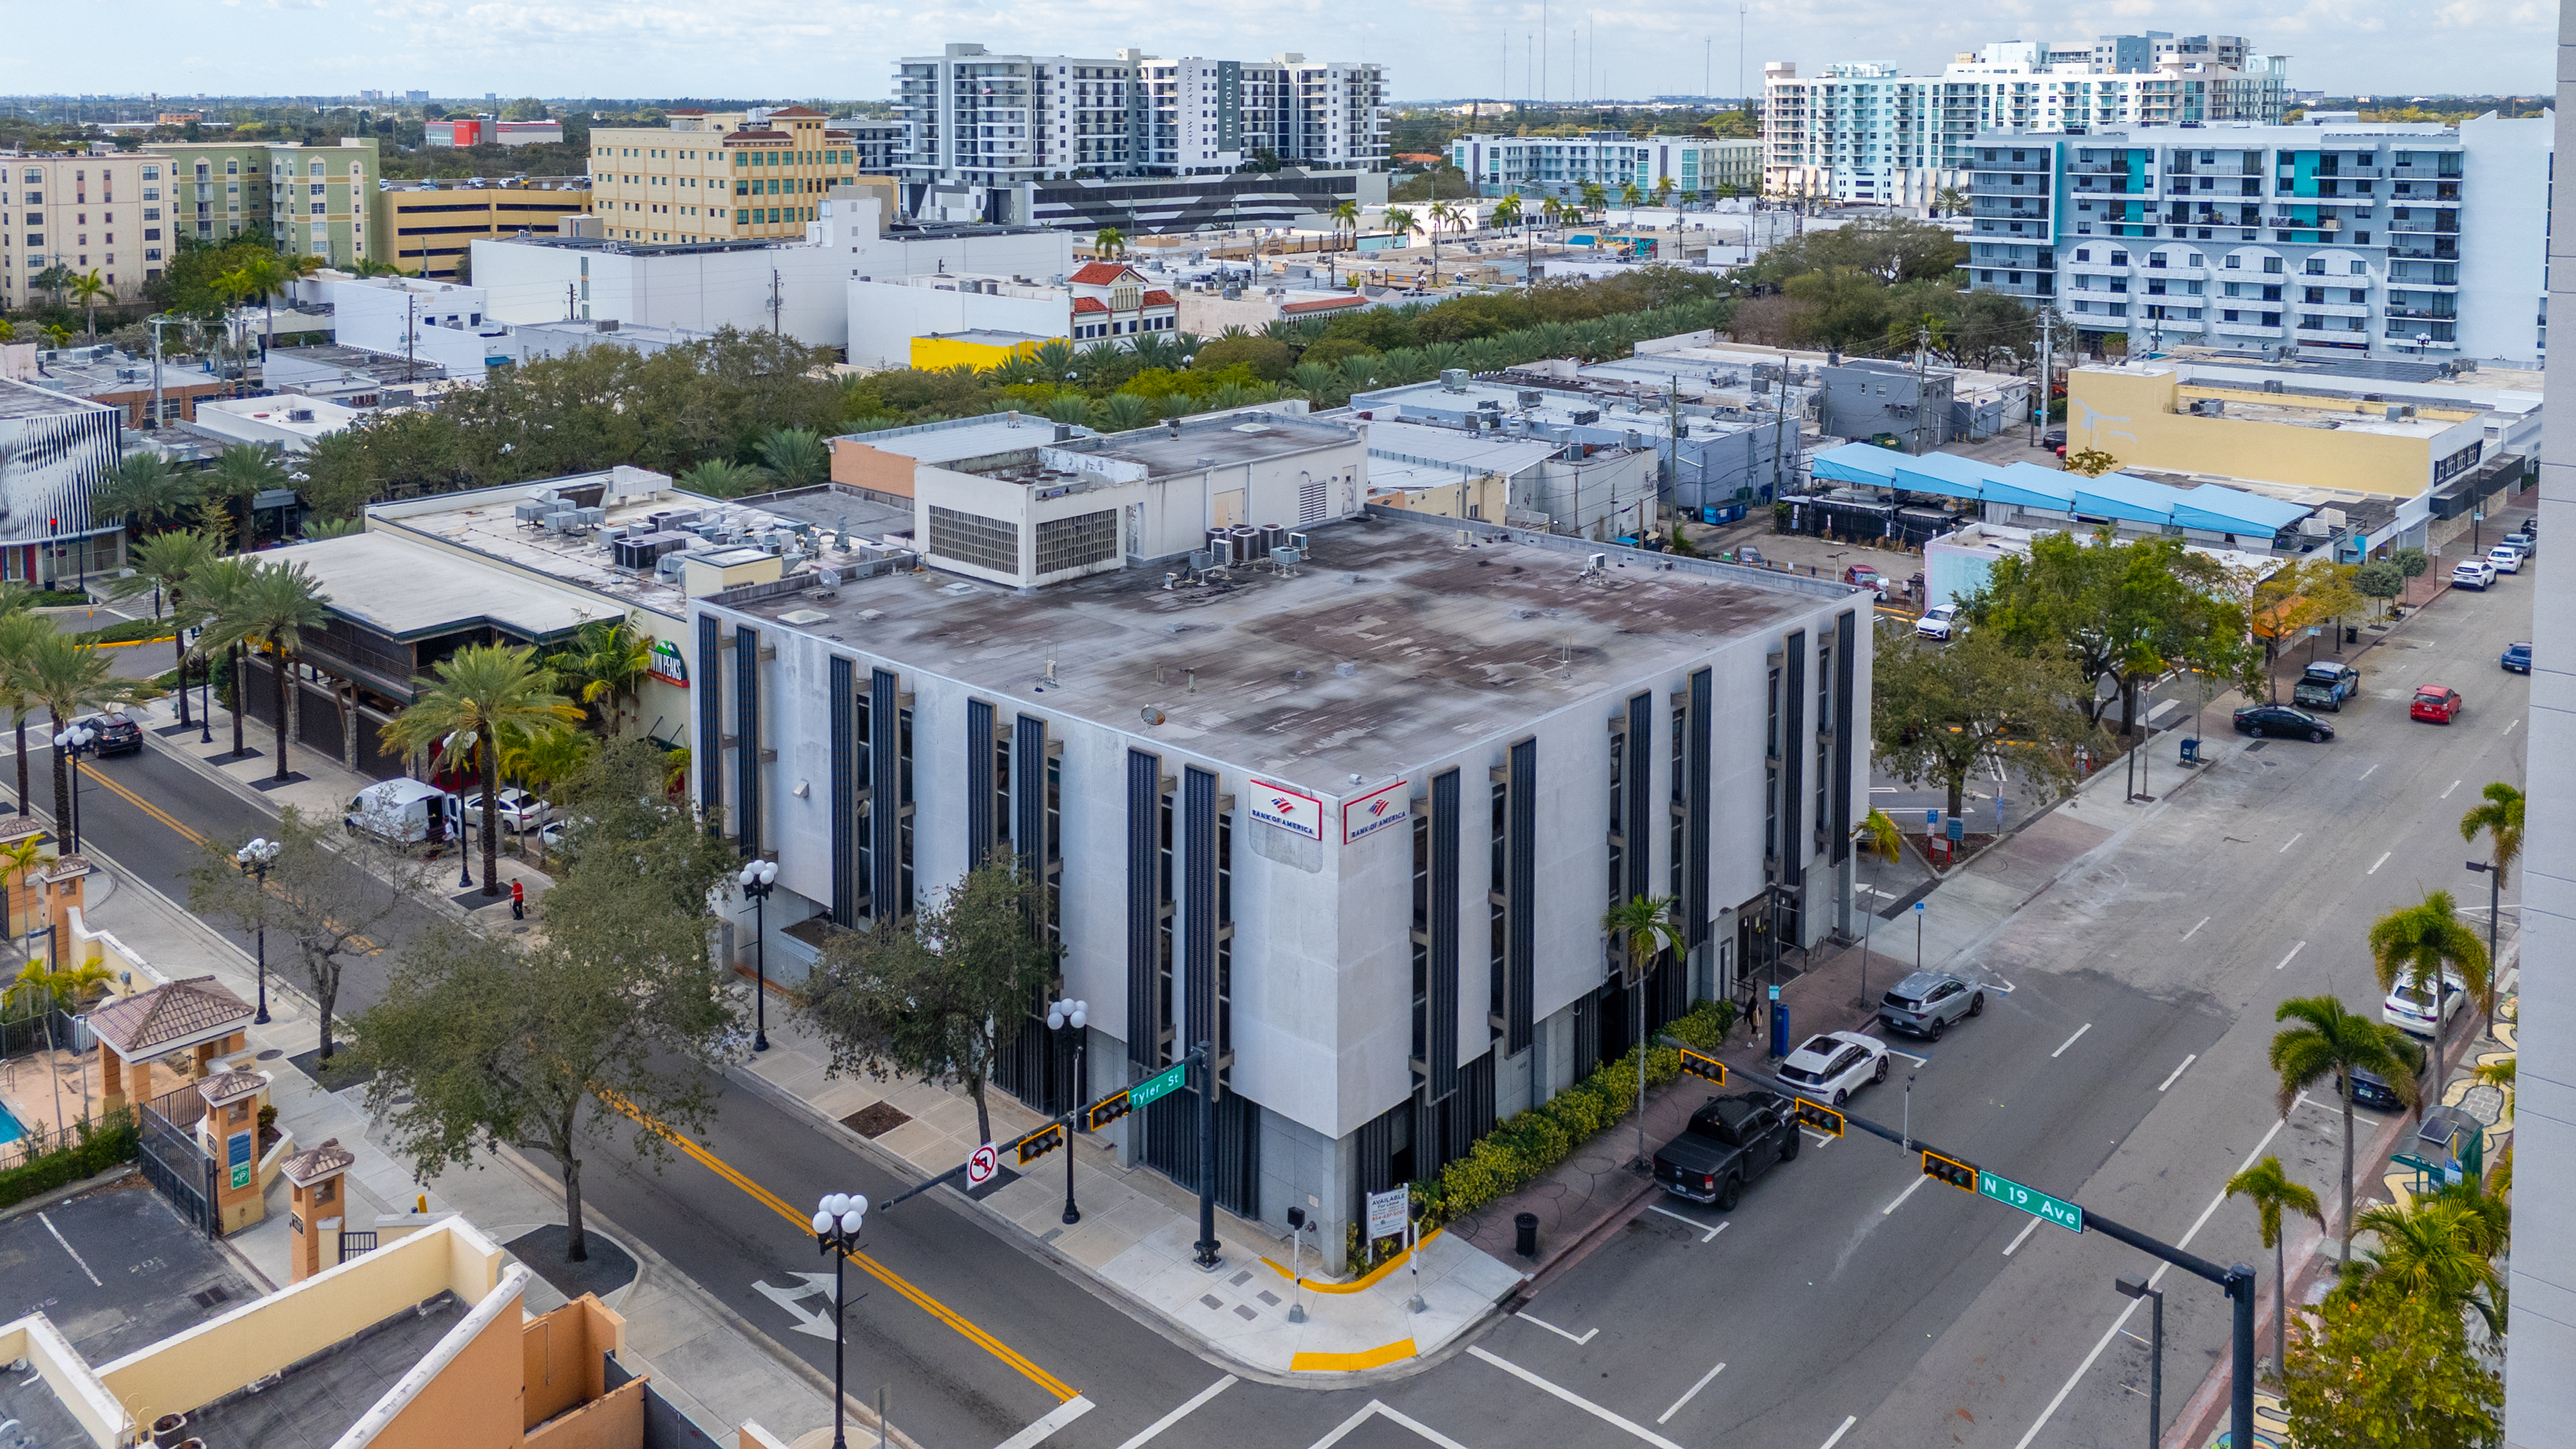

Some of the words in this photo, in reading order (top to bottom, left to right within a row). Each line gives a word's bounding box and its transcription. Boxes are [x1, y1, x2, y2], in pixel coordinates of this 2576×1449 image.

[647, 649, 662, 673] TWIN
[663, 654, 682, 680] PEAKS
[1252, 809, 1270, 821] BANK
[1282, 819, 1313, 834] AMERICA
[1351, 826, 1369, 838] BANK
[1370, 822, 1378, 830] OF
[1379, 811, 1406, 827] AMERICA
[1132, 1084, 1161, 1105] Tyler
[1168, 1073, 1178, 1087] St
[1372, 1192, 1405, 1206] AVAILABLE
[1985, 1177, 1996, 1194] N
[2009, 1187, 2028, 1204] 19
[2041, 1201, 2076, 1224] Ave
